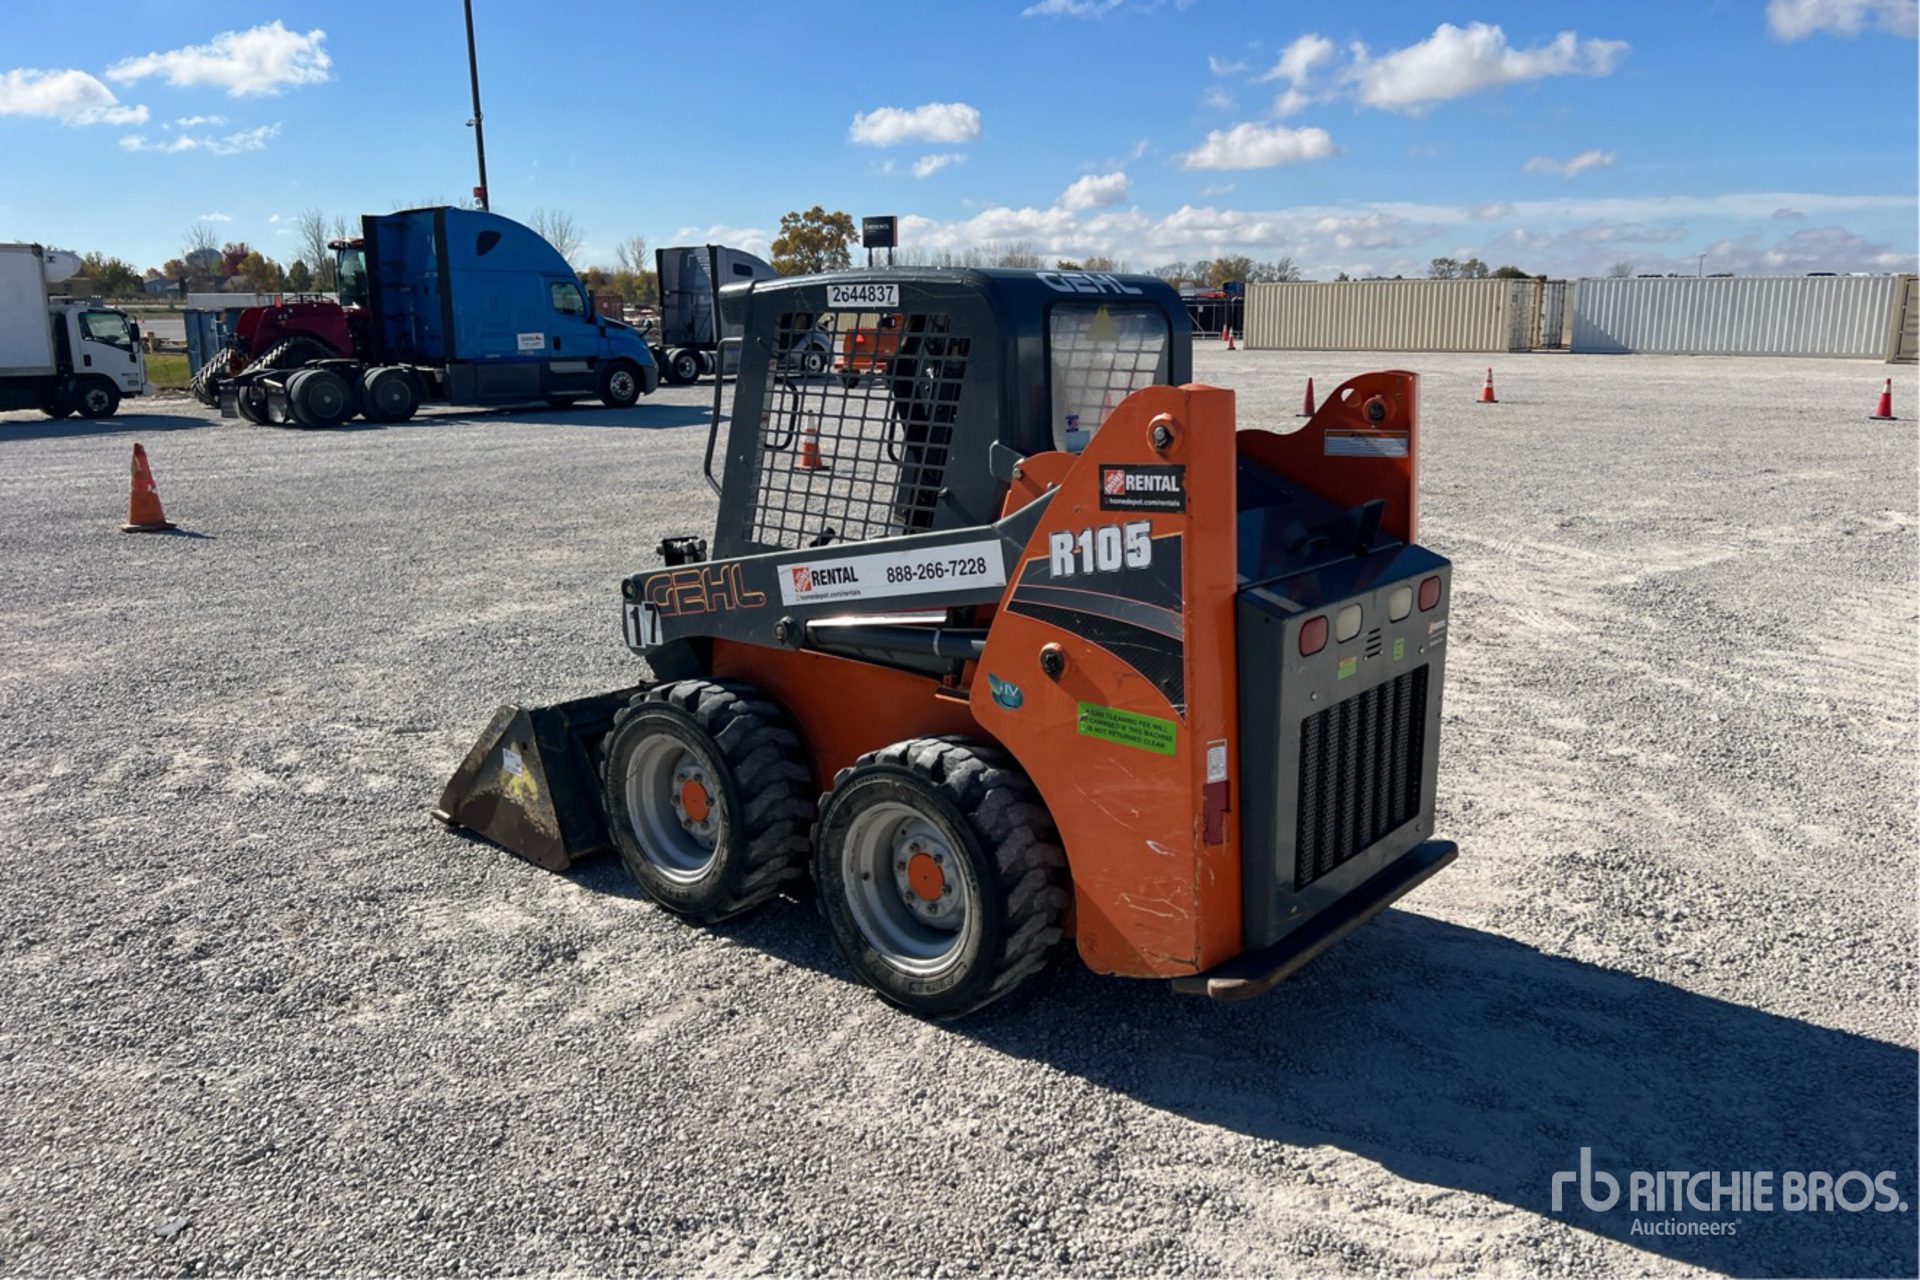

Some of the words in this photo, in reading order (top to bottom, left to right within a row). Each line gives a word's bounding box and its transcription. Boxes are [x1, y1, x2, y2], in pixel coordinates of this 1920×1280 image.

[833, 286, 894, 302] 2644837
[1036, 272, 1143, 294] GEHL
[1125, 475, 1180, 492] RENTAL
[1109, 498, 1180, 507] homedepot.com/rentals
[1050, 520, 1152, 578] R105
[811, 567, 859, 586] RENTAL
[886, 557, 987, 583] 888-266-7228
[644, 563, 767, 617] GEHL
[630, 602, 657, 646] 17
